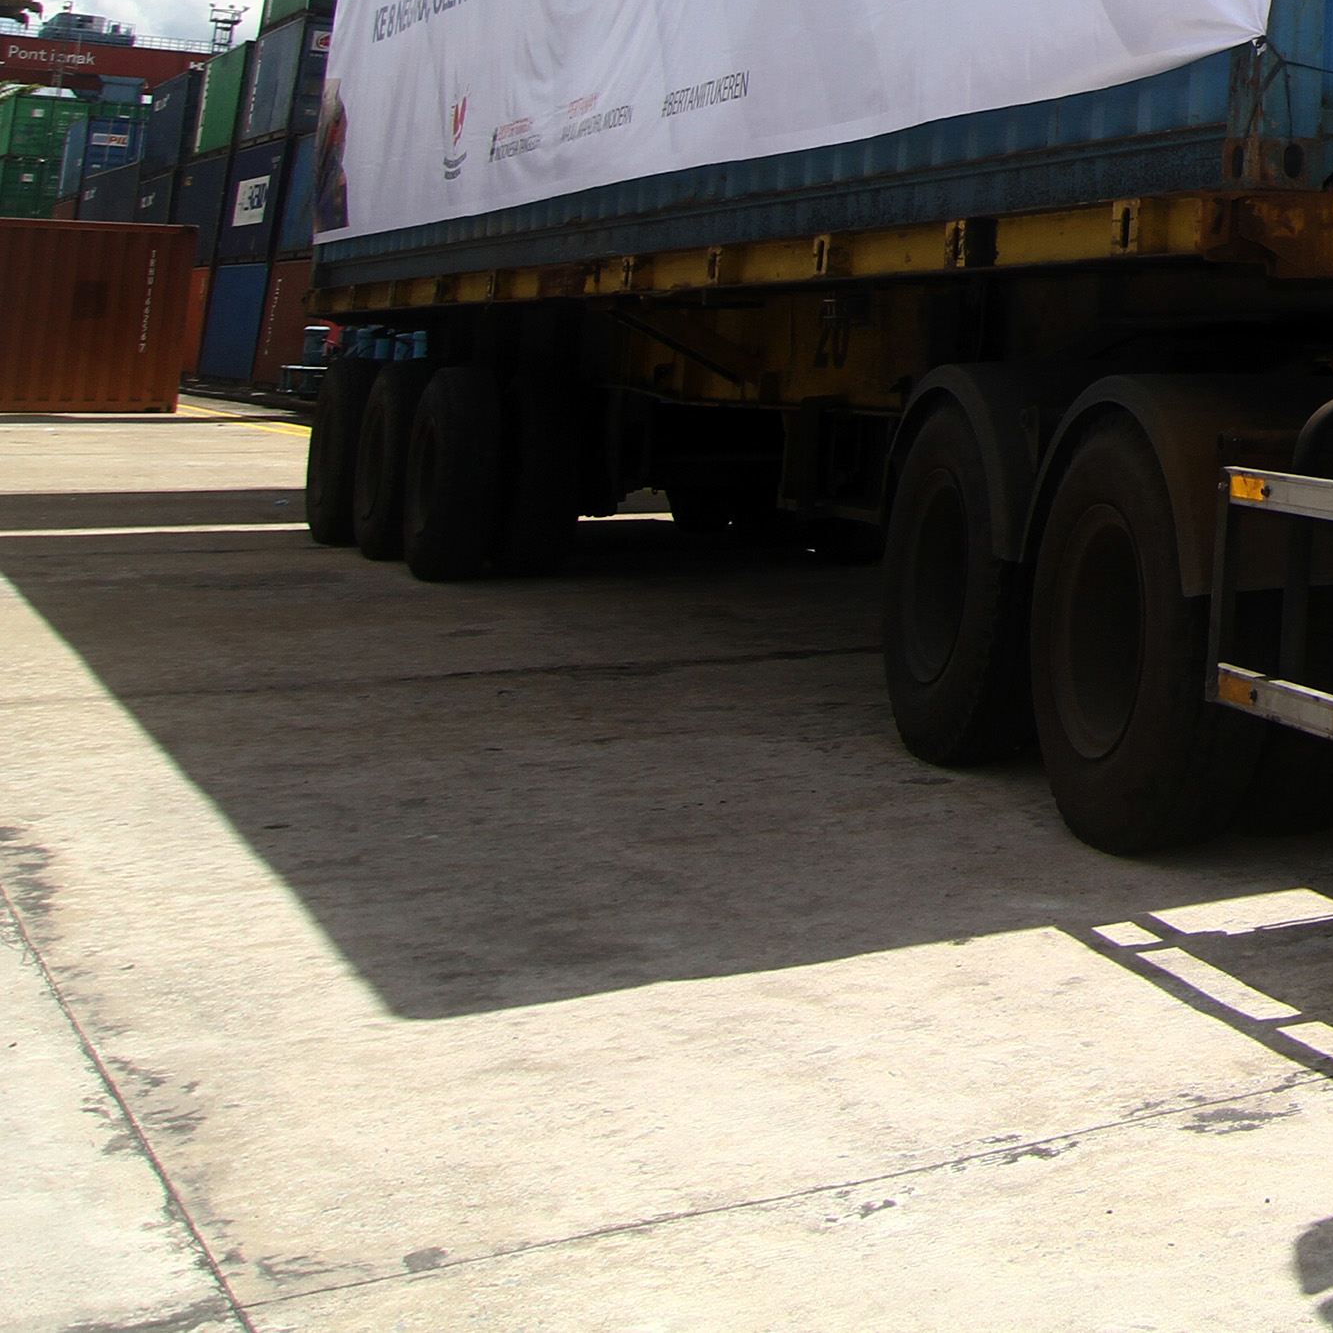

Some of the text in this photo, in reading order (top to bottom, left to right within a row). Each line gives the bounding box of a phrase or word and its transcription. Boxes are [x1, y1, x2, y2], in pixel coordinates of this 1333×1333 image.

[372, 4, 389, 44] KE
[387, 3, 397, 38] 8
[108, 135, 128, 146] PIL
